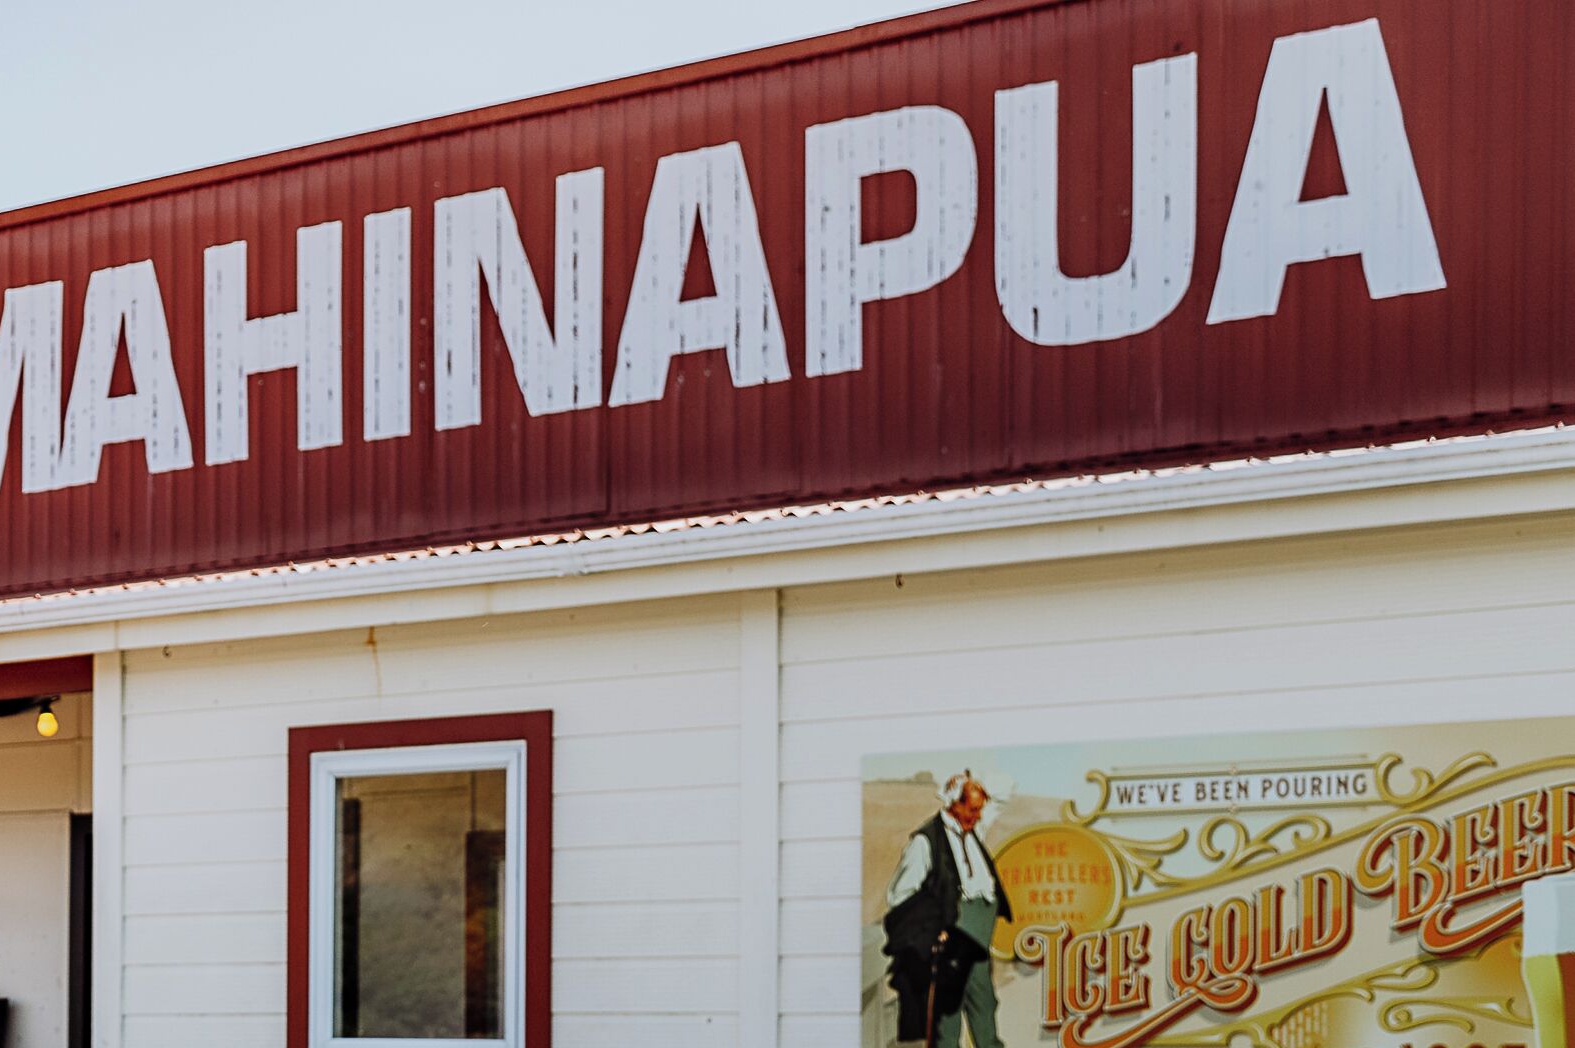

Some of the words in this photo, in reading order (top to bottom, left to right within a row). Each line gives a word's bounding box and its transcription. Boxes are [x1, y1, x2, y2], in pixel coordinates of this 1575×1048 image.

[1116, 782, 1182, 804] WE'VE
[1194, 780, 1250, 802] BEEN
[1261, 773, 1368, 798] POURING
[1033, 842, 1067, 857] THE
[1002, 863, 1112, 887] TRAVELLERS
[1029, 889, 1075, 905] REST
[1014, 921, 1152, 1032] ICE
[1166, 867, 1354, 1014] COLD
